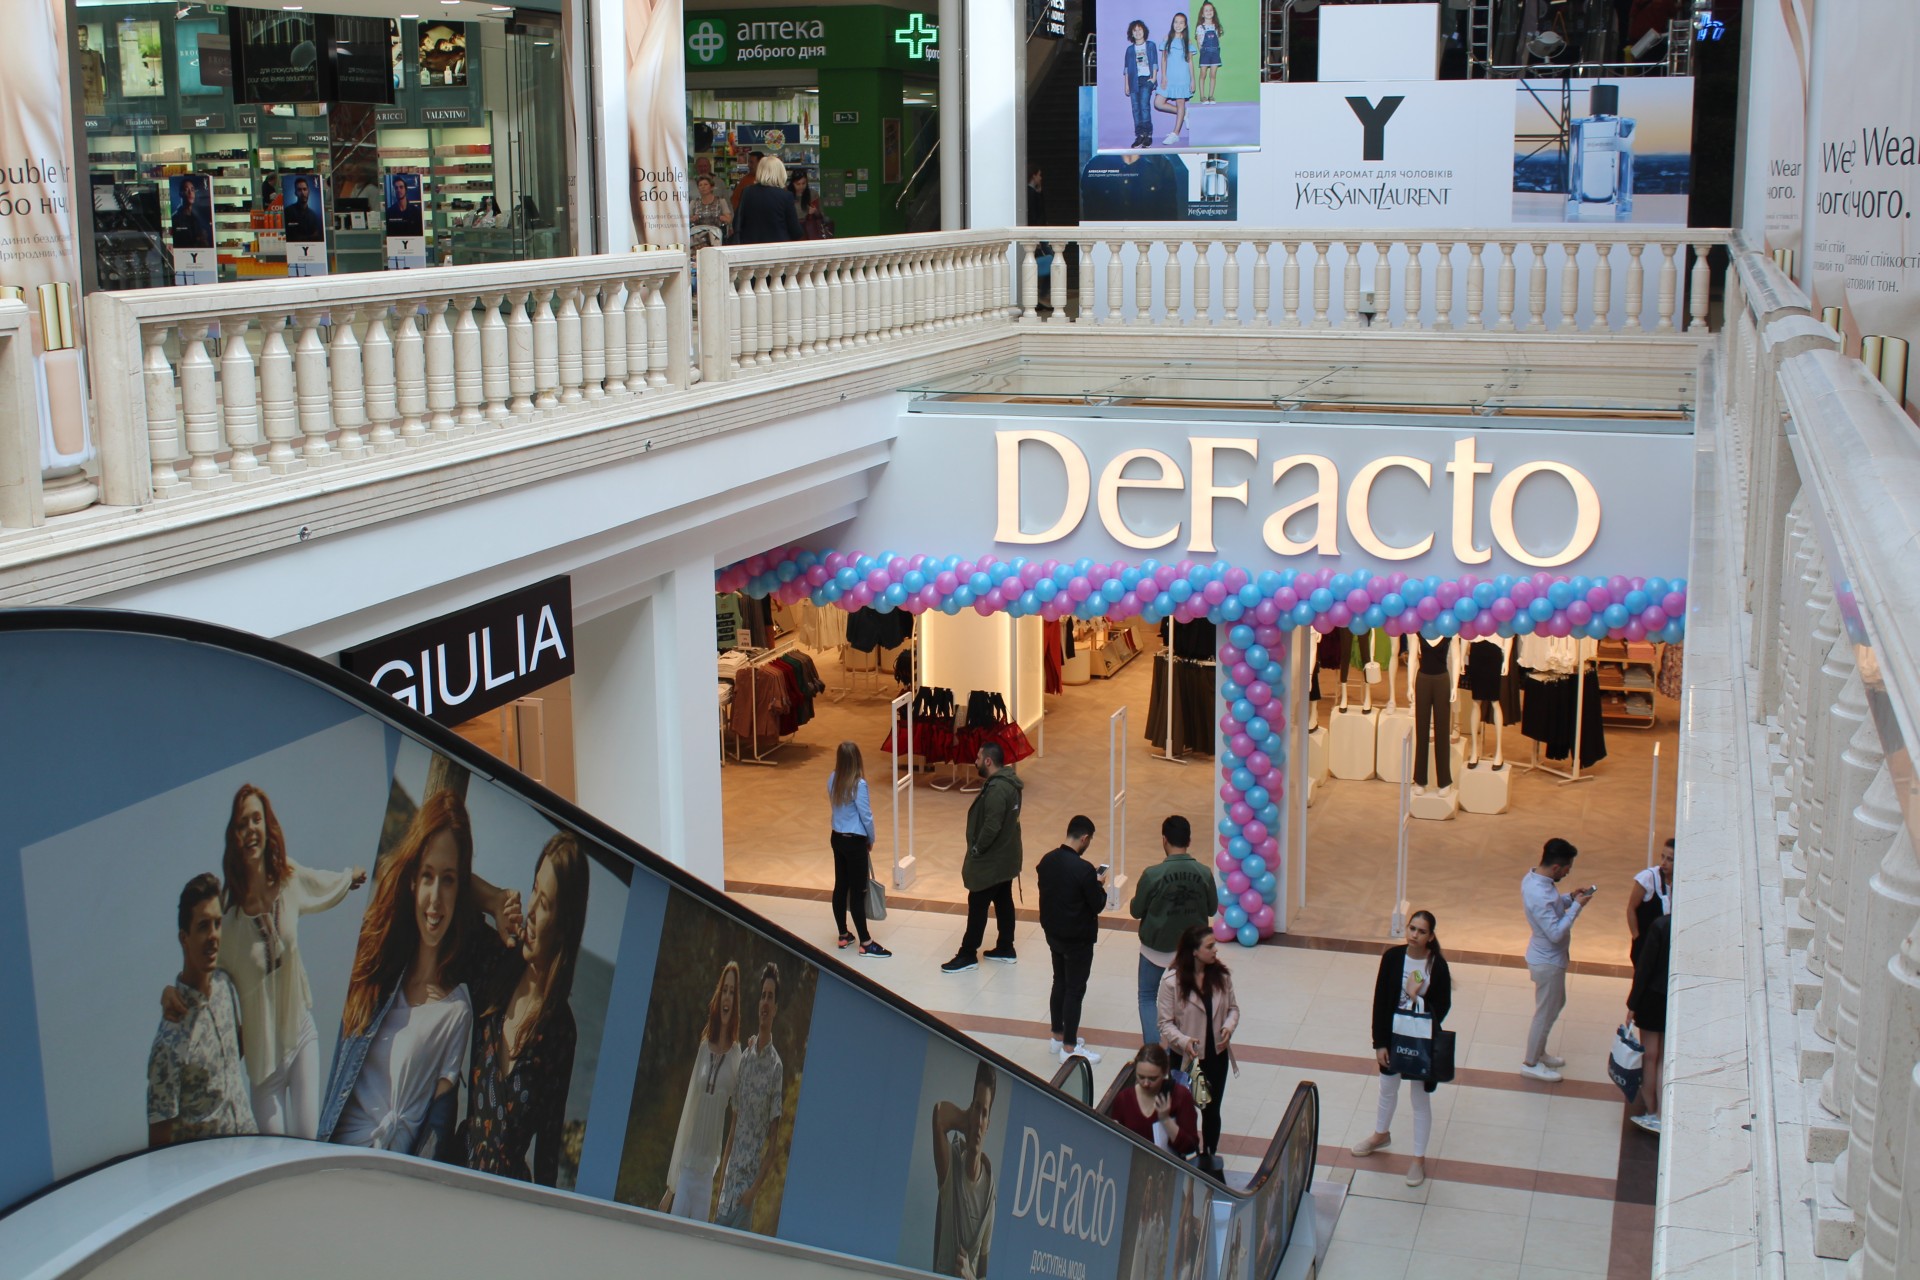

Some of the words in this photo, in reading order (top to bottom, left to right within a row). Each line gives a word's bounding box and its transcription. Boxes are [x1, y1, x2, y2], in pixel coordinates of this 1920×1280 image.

[737, 20, 825, 41] аптека
[737, 44, 796, 61] доброго
[798, 45, 826, 60] дня
[382, 112, 403, 120] RICCI
[426, 110, 466, 119] VALENTINO
[1345, 96, 1406, 161] Y
[1863, 126, 1920, 166] Wea
[633, 167, 683, 183] Double
[1295, 170, 1330, 179] НОВИЙ
[1333, 170, 1375, 179] АРОМАТ
[1376, 170, 1397, 179] ДЛЯ
[1400, 170, 1453, 179] ЧОЛОВІКІВ
[1771, 159, 1802, 176] Wear
[640, 186, 668, 202] або
[1852, 190, 1911, 219] чого.
[302, 246, 309, 257] Y
[402, 240, 409, 250] Y
[190, 252, 198, 264] Y
[993, 430, 1601, 568] DeFacto
[369, 604, 567, 717] GIULIA
[1011, 1126, 1116, 1247] DeFacto
[1030, 1250, 1067, 1278] ДОСТУПНА
